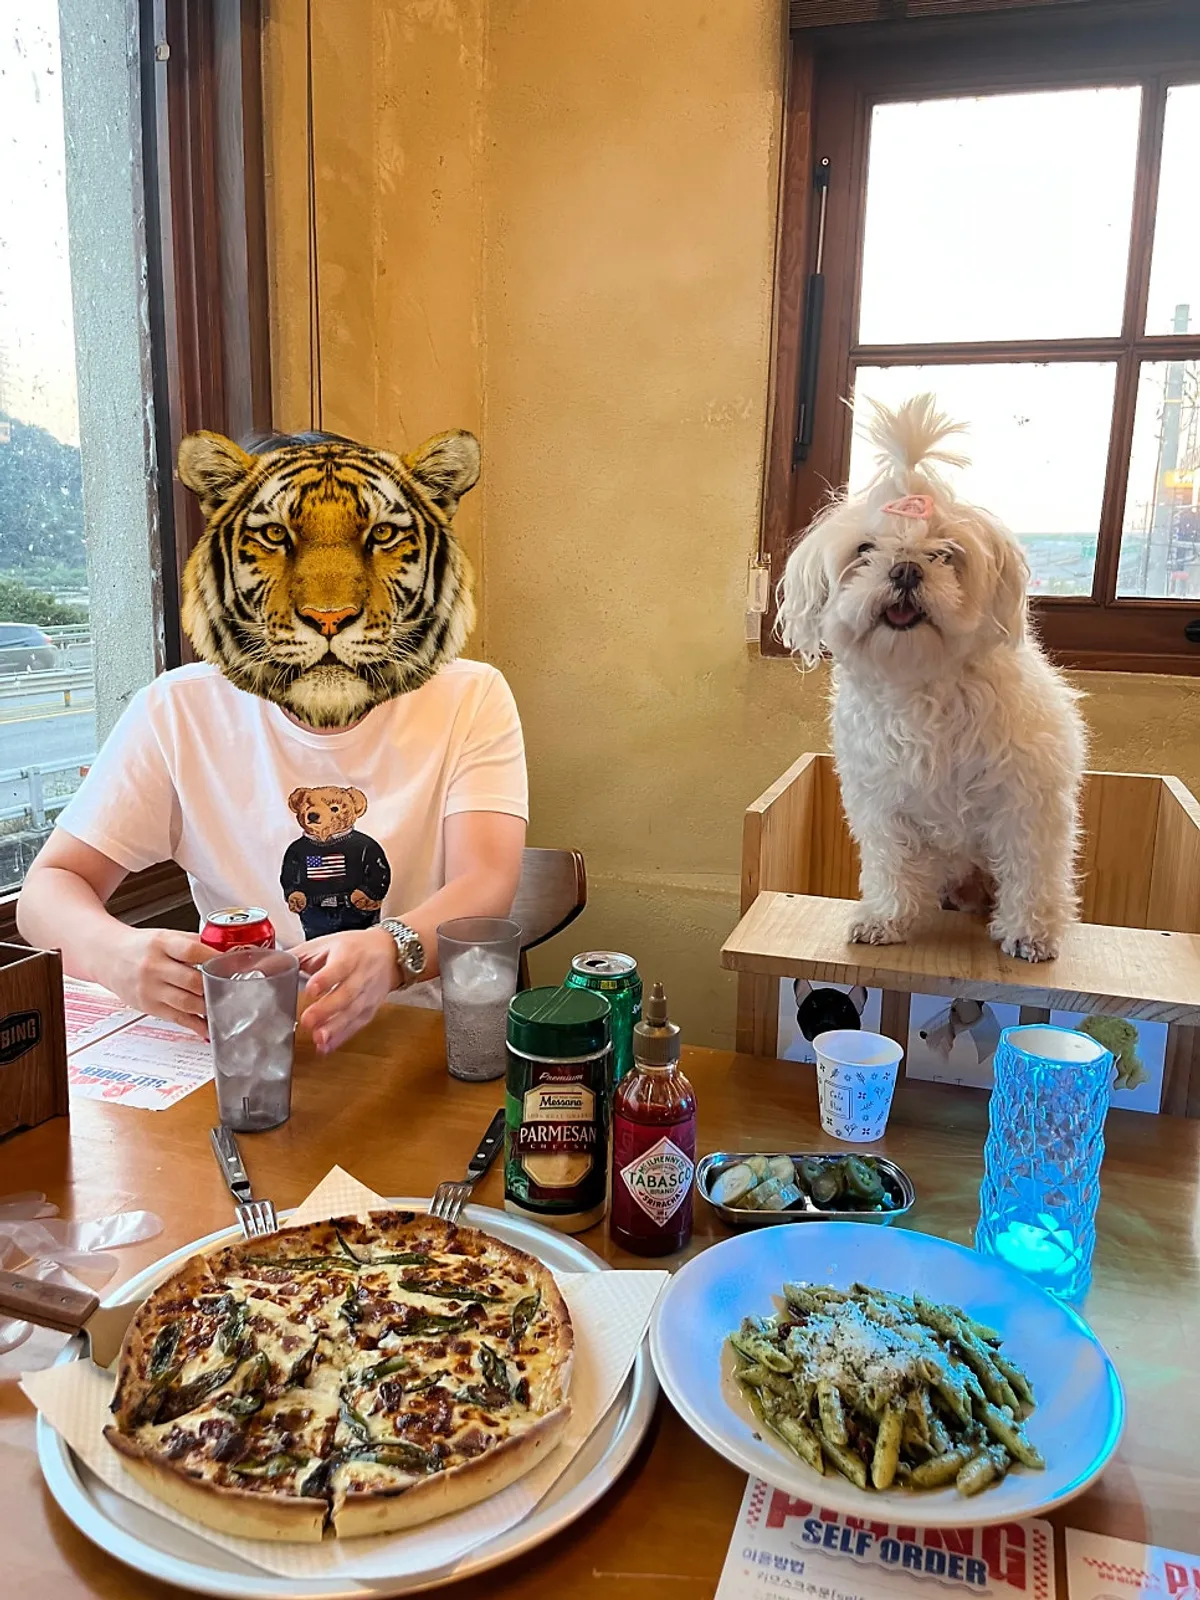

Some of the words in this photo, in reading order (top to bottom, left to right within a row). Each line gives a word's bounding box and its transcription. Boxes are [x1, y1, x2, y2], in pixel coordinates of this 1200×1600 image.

[79, 1065, 133, 1082] ORDER
[539, 1071, 584, 1081] Premium
[132, 1077, 168, 1088] SELF
[520, 1125, 597, 1144] PARMESAN
[628, 1166, 691, 1188] TABASCO
[642, 1193, 680, 1208] SRIRACHA
[802, 1518, 873, 1557] SELF
[880, 1538, 988, 1586] ORDER
